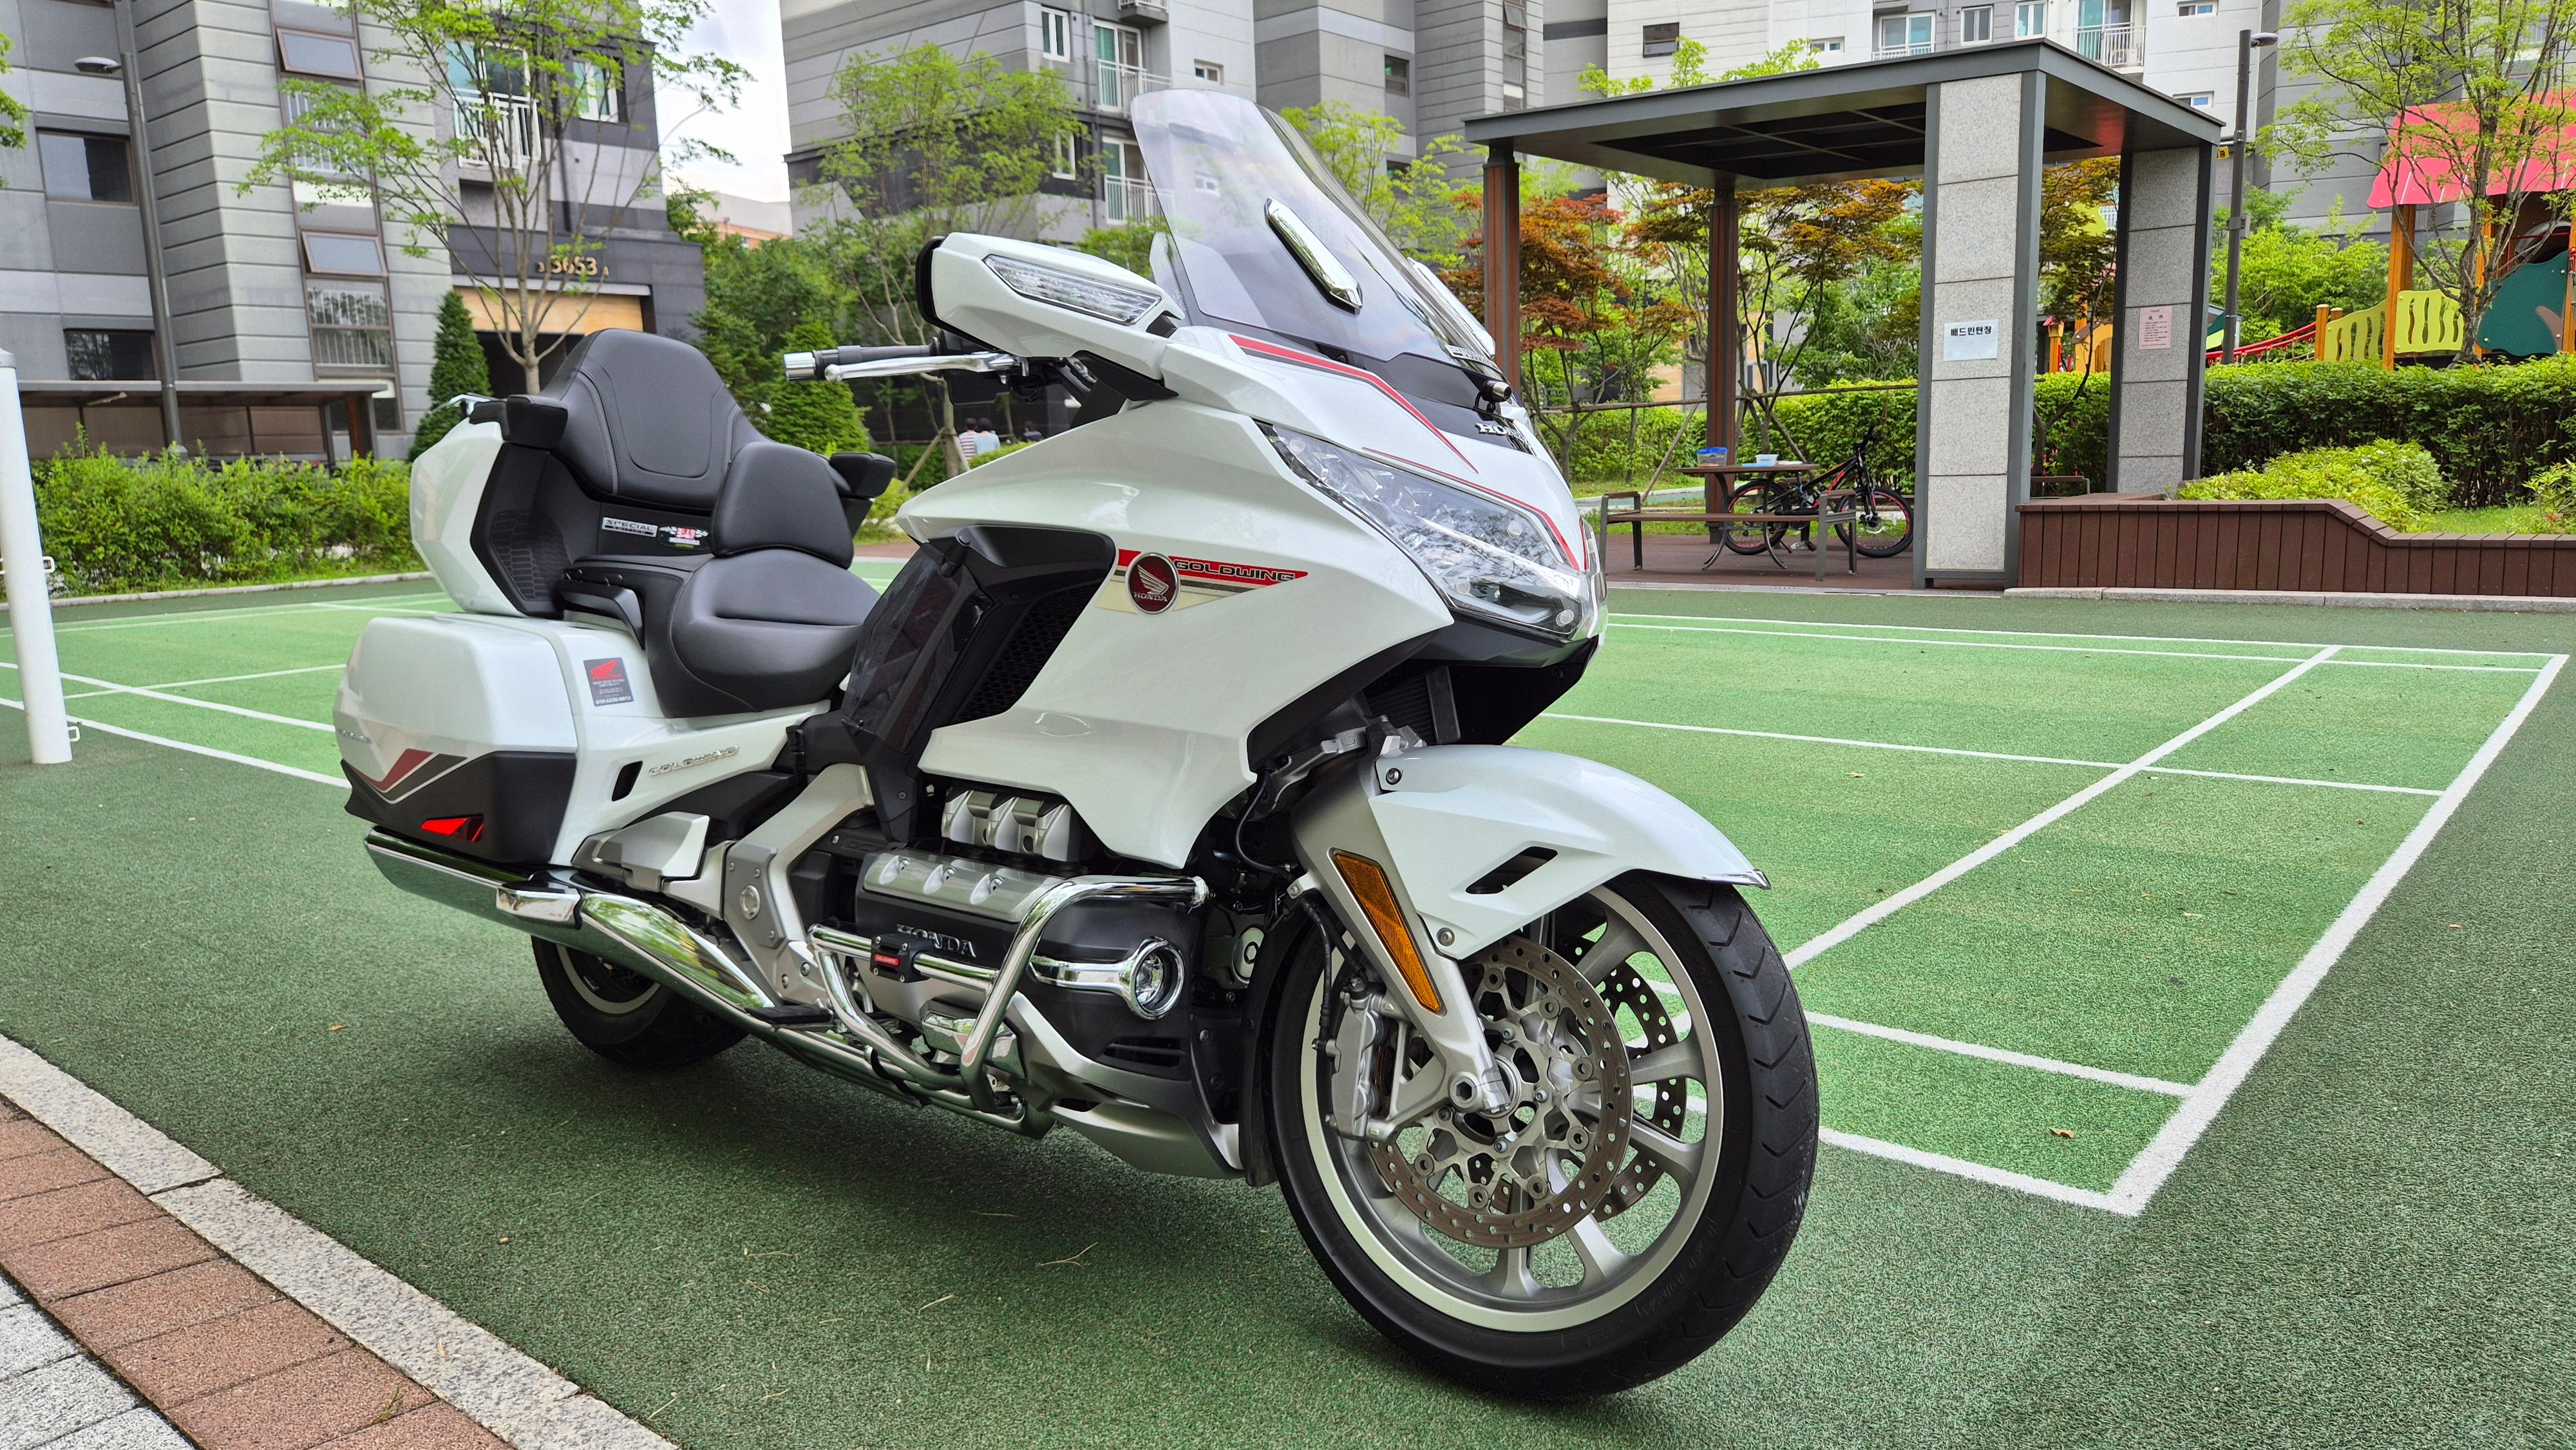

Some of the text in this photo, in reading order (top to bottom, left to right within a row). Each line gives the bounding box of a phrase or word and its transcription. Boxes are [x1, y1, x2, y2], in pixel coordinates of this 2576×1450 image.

[1950, 326, 1992, 336] 배드민턴장
[607, 519, 654, 531] SPECIAL
[1173, 560, 1294, 581] GOLDWING
[1133, 592, 1168, 602] HONDA
[649, 746, 739, 776] GOLDWING
